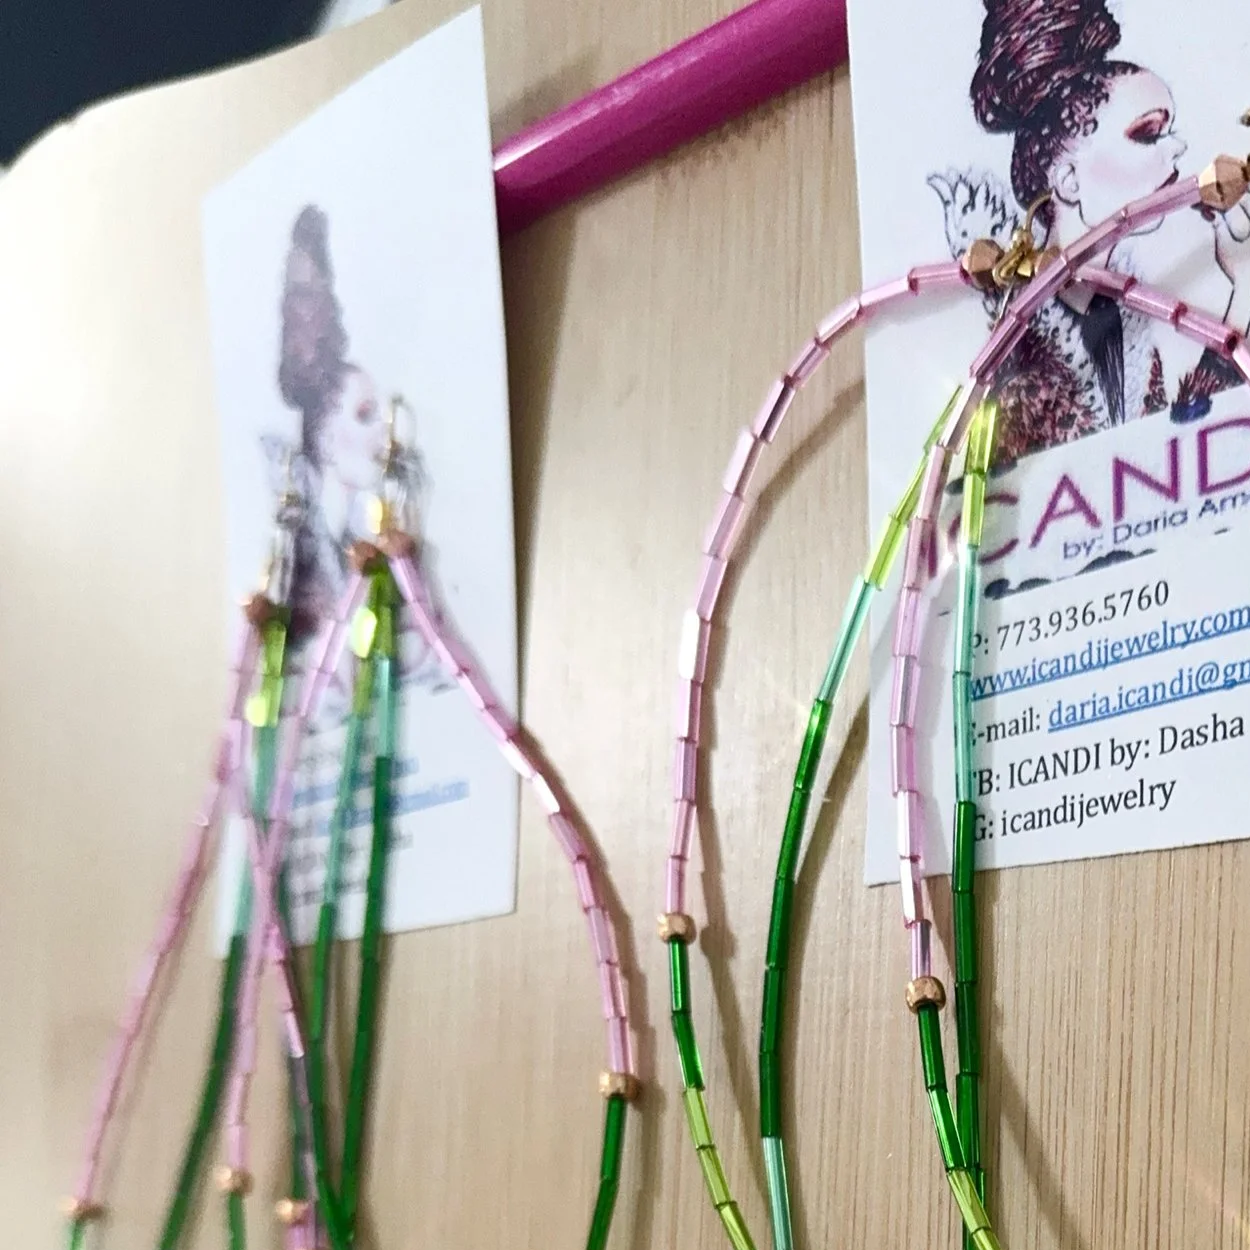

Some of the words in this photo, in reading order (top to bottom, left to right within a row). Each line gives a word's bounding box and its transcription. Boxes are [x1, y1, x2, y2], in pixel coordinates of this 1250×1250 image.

[1062, 534, 1104, 560] by:
[1112, 508, 1188, 545] Daria
[996, 580, 1170, 652] 773.936.5760
[971, 708, 1041, 747] -mail:
[1008, 742, 1102, 790] ICANDI
[1109, 737, 1151, 772] by:
[1158, 713, 1246, 756] Dasha
[1000, 778, 1177, 838] icandijewelry
